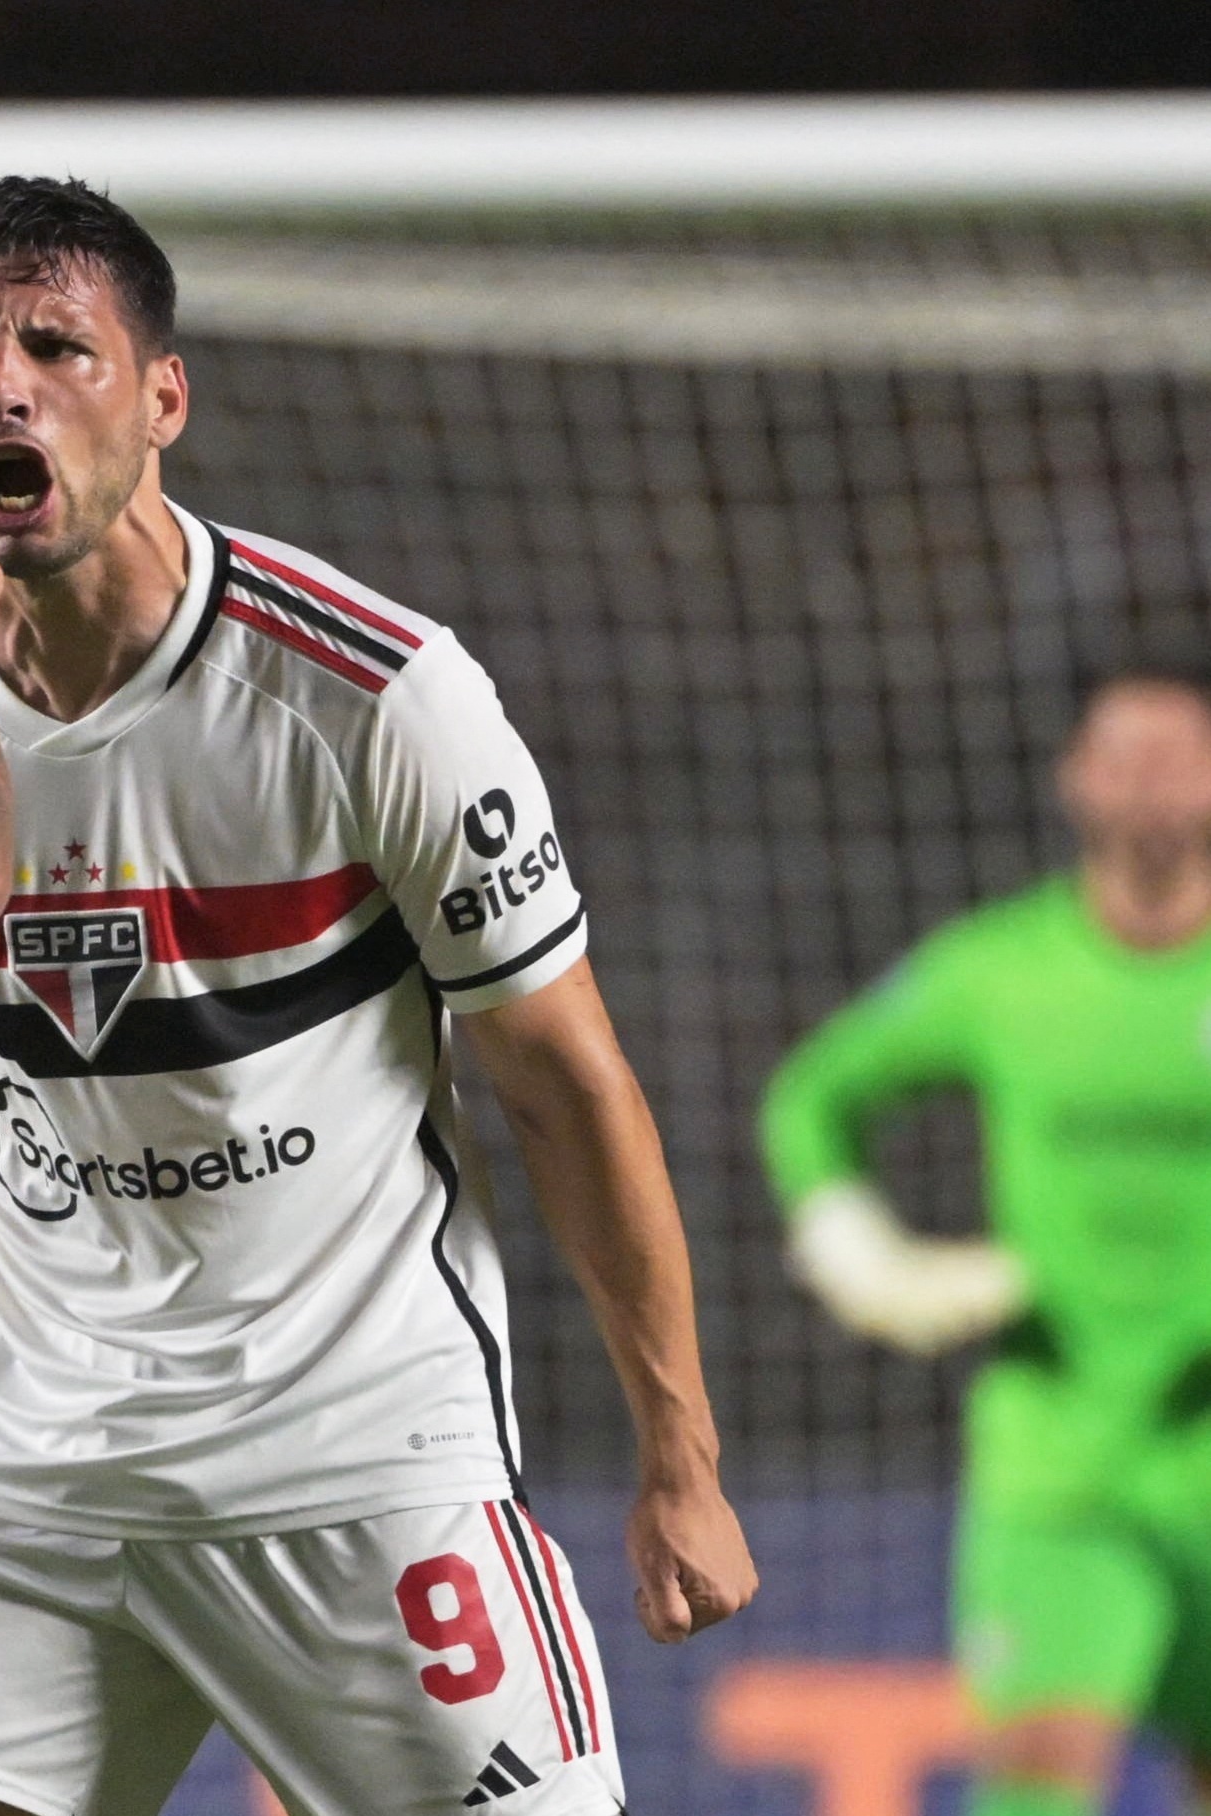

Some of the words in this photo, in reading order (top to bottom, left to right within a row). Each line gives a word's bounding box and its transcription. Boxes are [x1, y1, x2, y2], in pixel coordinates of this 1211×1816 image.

[440, 830, 560, 936] Bitso
[16, 920, 136, 958] SPFC
[10, 1117, 316, 1200] Sportsbet.io
[395, 1552, 506, 1705] 9
